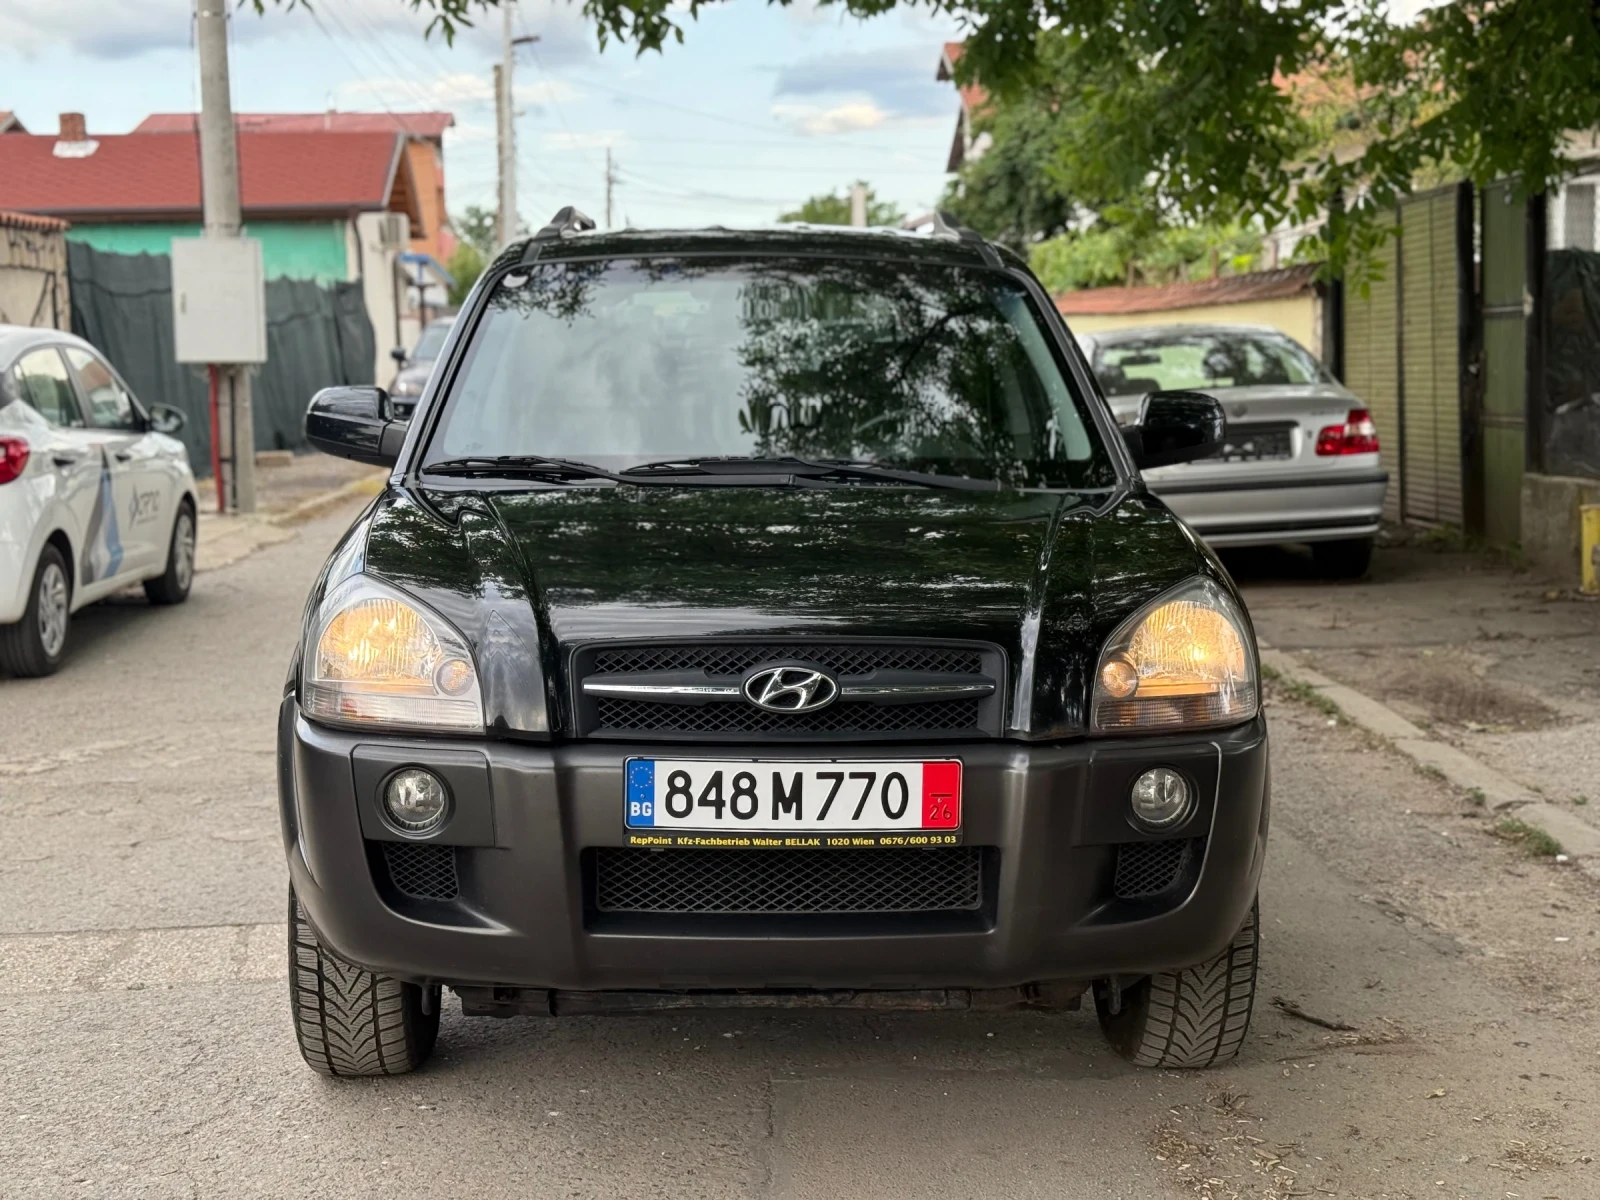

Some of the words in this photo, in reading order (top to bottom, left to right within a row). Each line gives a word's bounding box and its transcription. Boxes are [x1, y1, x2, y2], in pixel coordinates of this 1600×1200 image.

[665, 769, 759, 820] 848
[771, 771, 803, 821] M
[816, 771, 909, 821] 770
[630, 802, 652, 817] BG
[929, 804, 953, 820] 26
[630, 836, 672, 845] RepPoint
[677, 837, 751, 846] Kfz-Fachbetrieb
[752, 838, 783, 846] Walter
[785, 838, 821, 846] BELLAK
[826, 838, 850, 846] 1020
[852, 838, 875, 846] Wien
[880, 836, 928, 846] 0676/600
[930, 836, 942, 844] 93
[944, 835, 957, 844] 03
